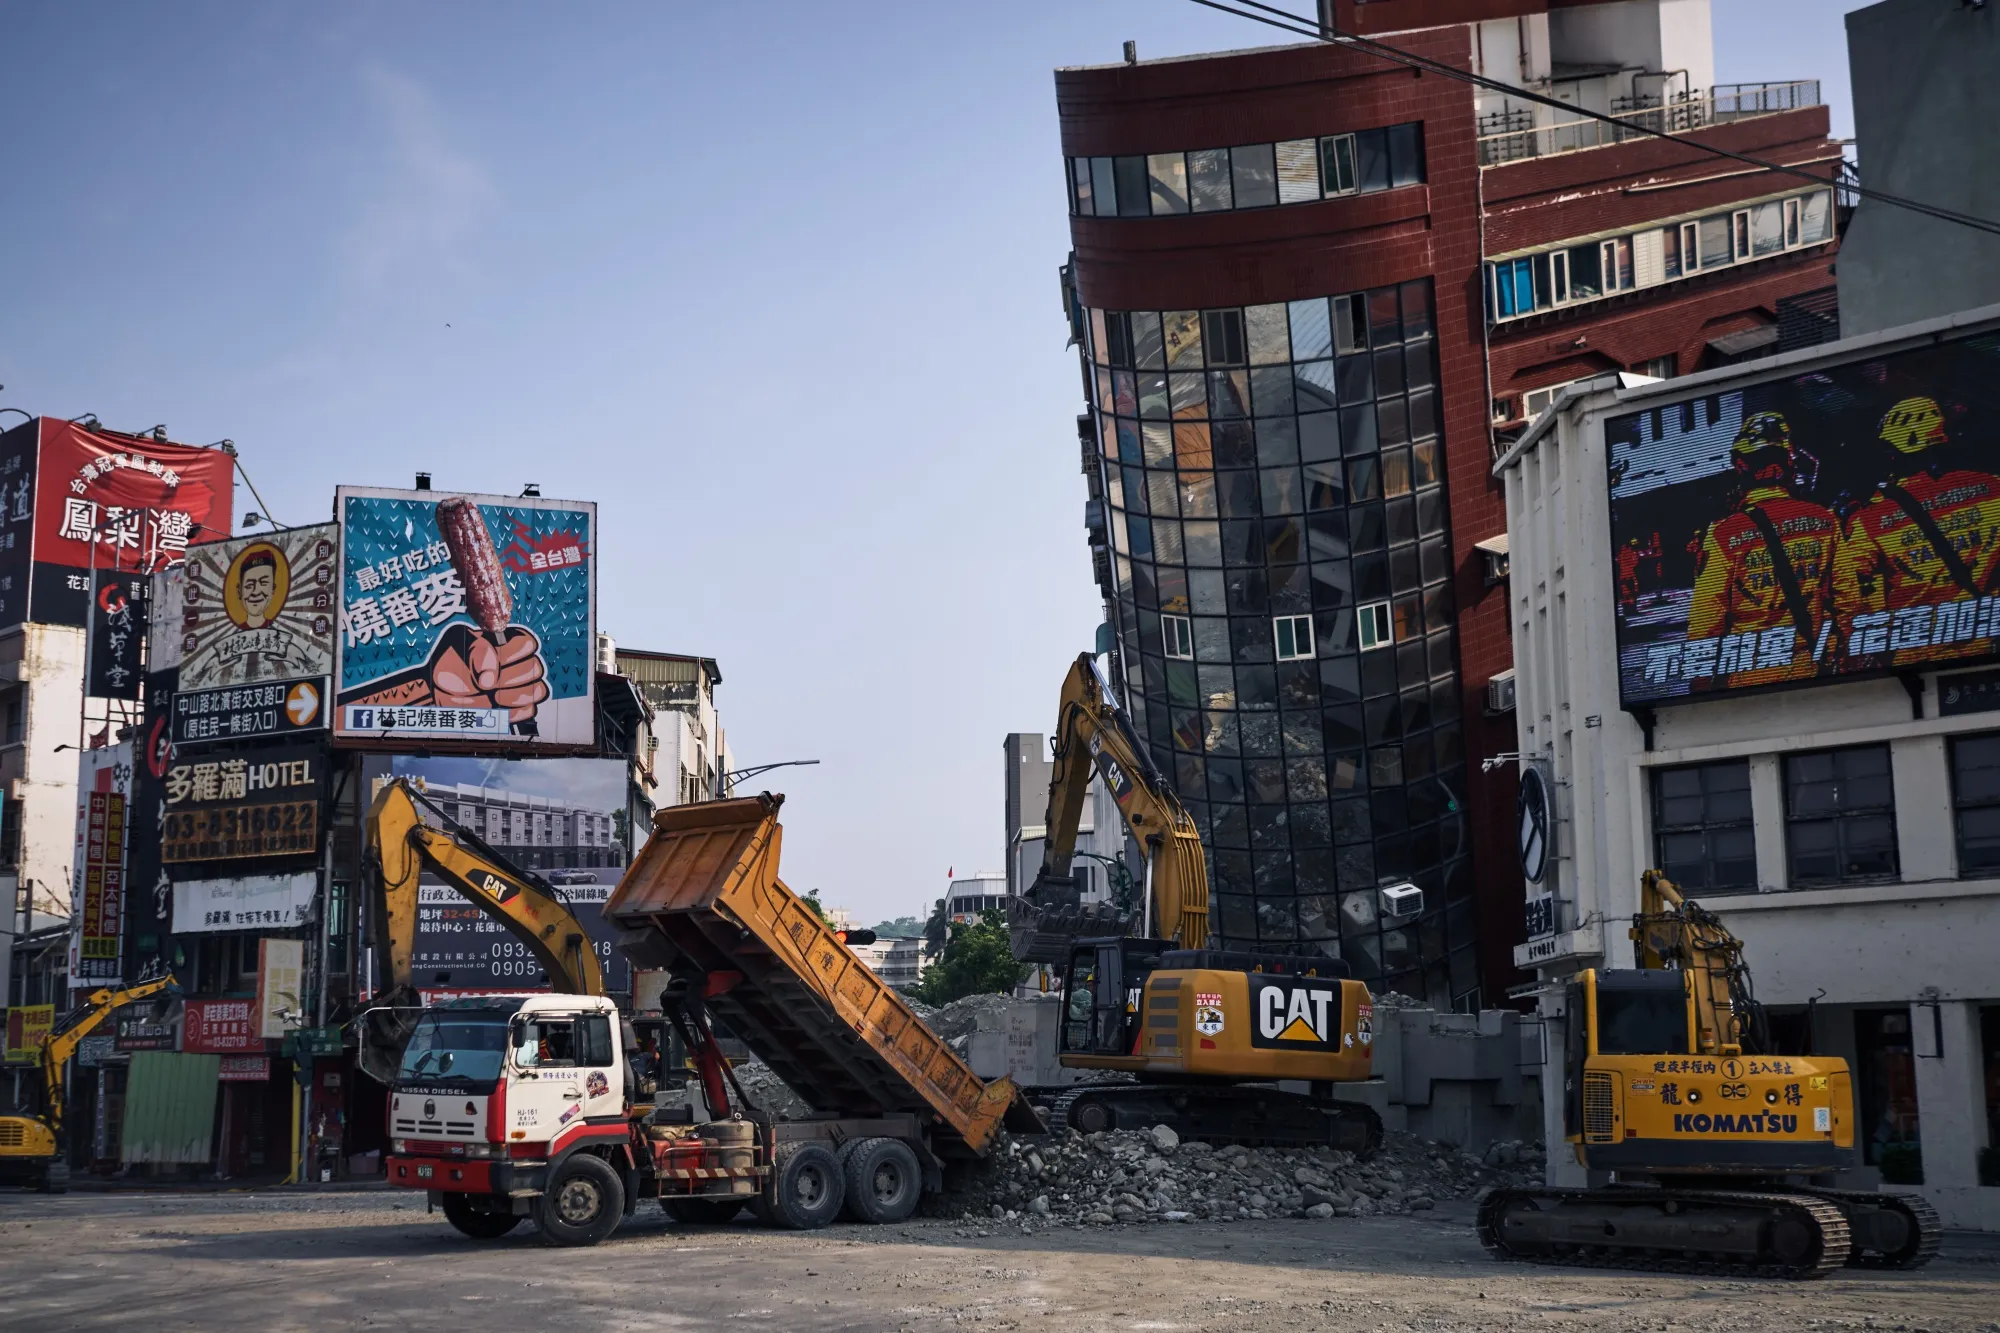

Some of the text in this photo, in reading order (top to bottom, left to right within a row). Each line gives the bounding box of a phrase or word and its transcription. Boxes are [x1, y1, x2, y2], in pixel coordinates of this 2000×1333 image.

[69, 453, 181, 495] 台灣冠軍鳳梨酥
[59, 497, 192, 575] 鳳梨灣
[355, 540, 452, 592] 最好吃的
[529, 545, 582, 570] 全台灣
[315, 545, 329, 632] 別無分號
[341, 567, 468, 649] 燒番麥
[1643, 625, 1797, 684] 不要放棄
[179, 685, 286, 717] 中山路北濱街交叉路口
[377, 707, 477, 729] 林記燒番麥
[184, 710, 278, 739] (原住民一條街入口)
[166, 758, 315, 804] 多羅滿 HOTEL
[1108, 762, 1124, 793] CAT
[89, 796, 105, 860] 中華電信
[103, 870, 120, 934] 亞太電信
[483, 874, 507, 901] CAT
[1124, 987, 1142, 1013] AT
[1260, 985, 1333, 1042] CAT
[1748, 1061, 1795, 1076] 立入禁止
[1660, 1083, 1804, 1107] 龍 得
[1674, 1109, 1797, 1134] KOMATSU
